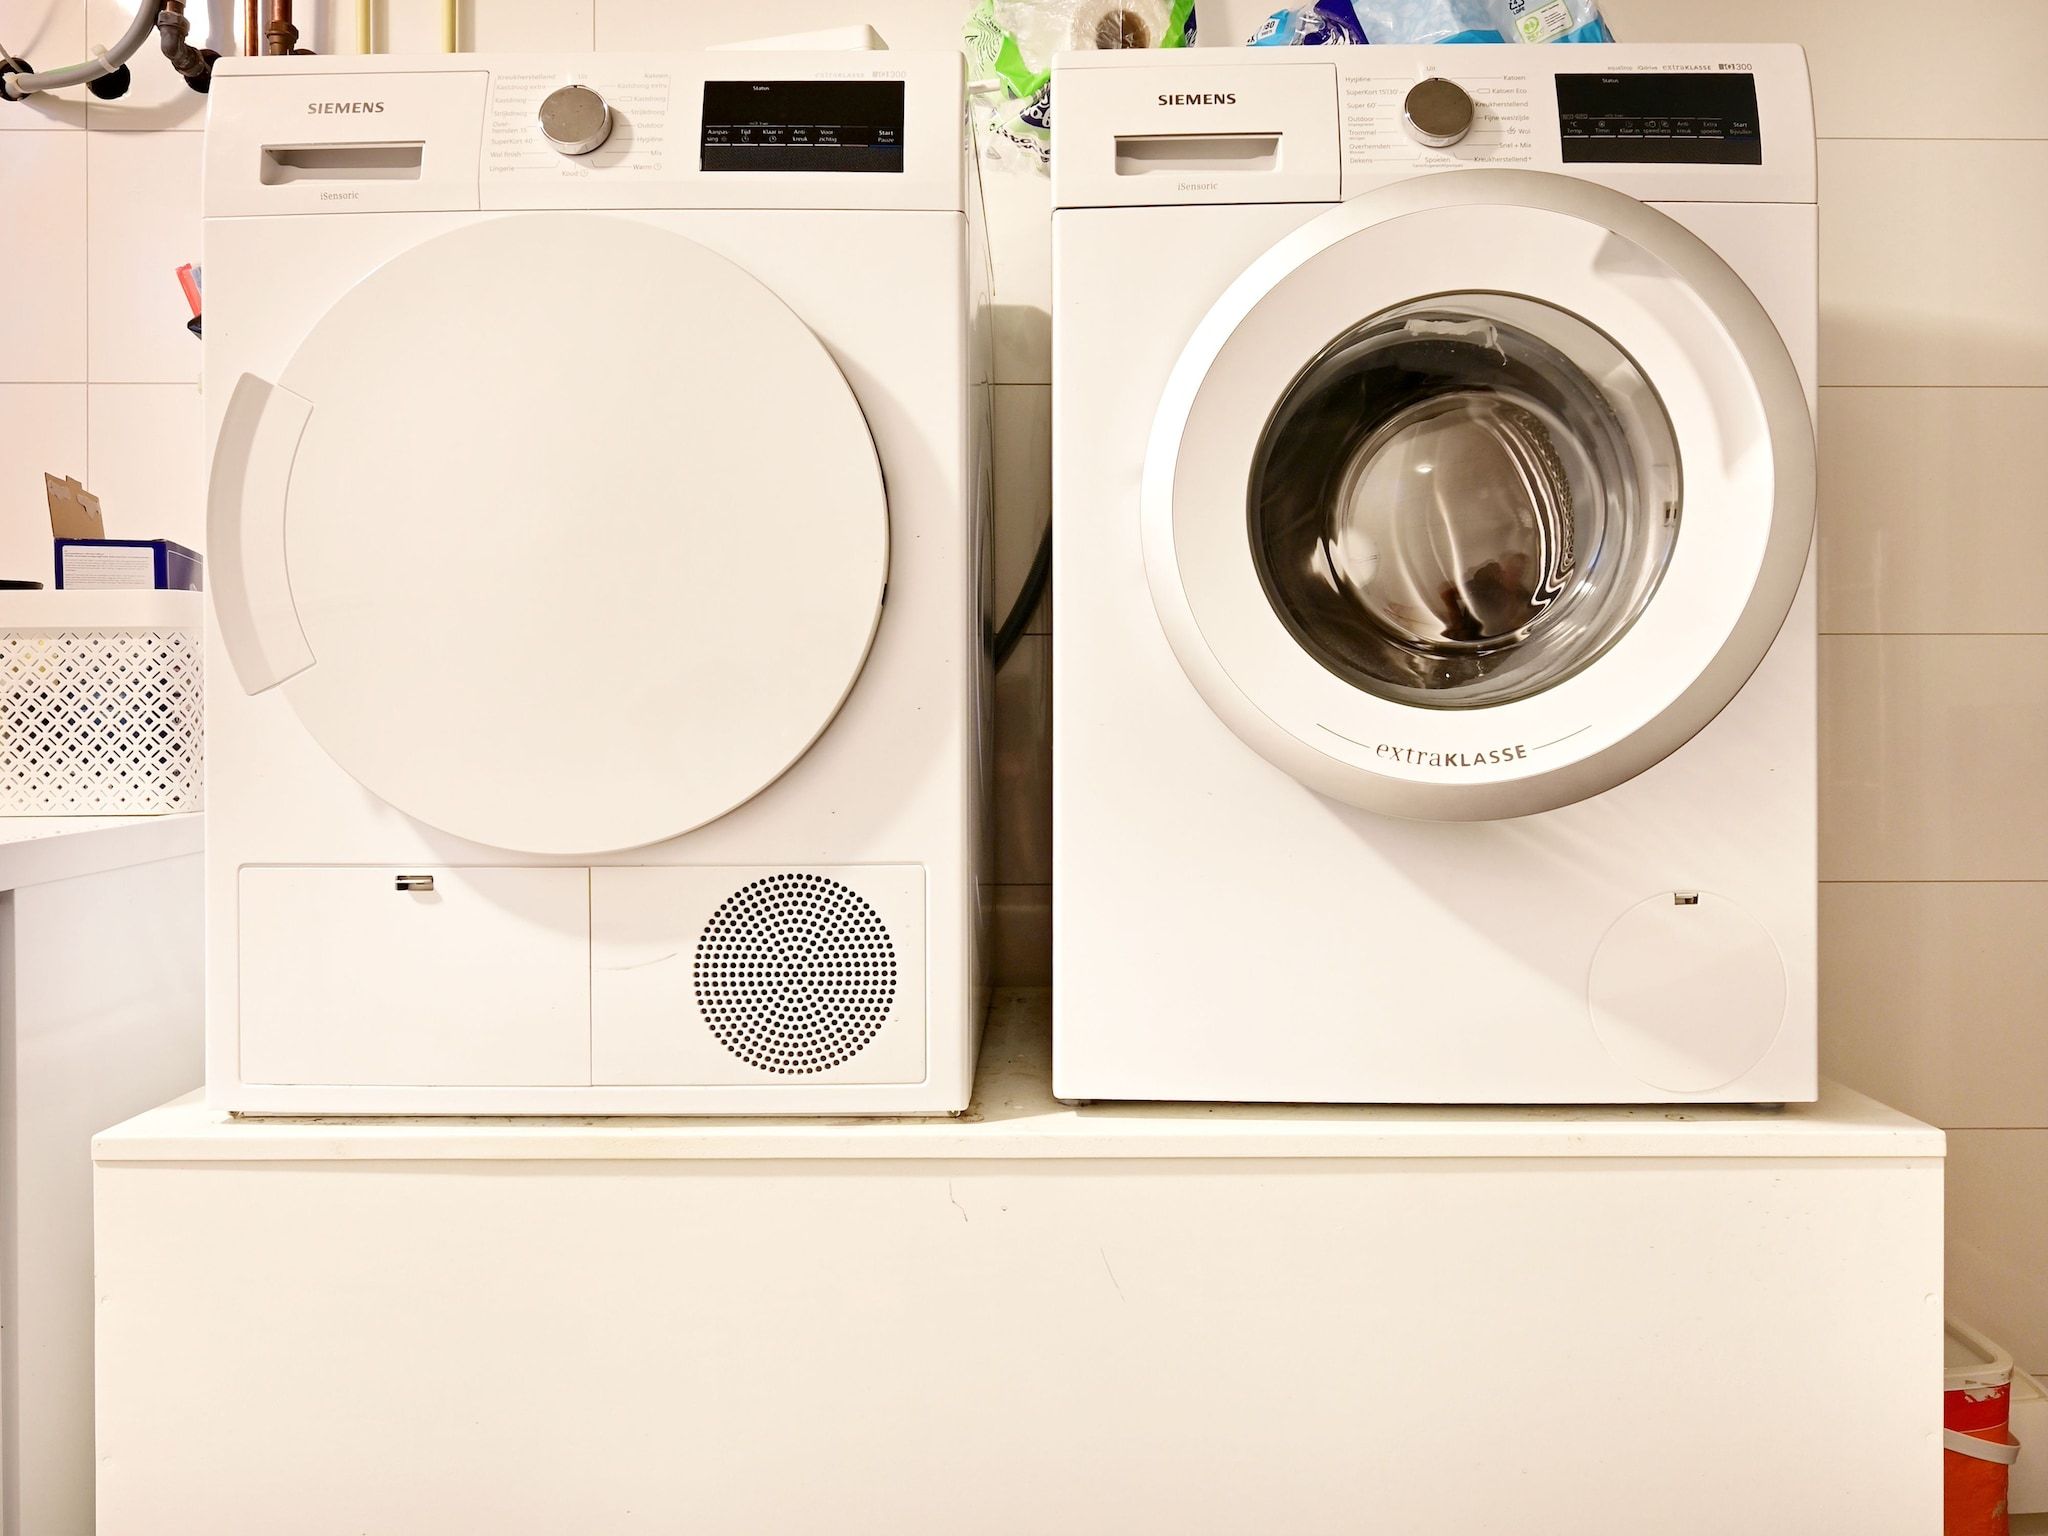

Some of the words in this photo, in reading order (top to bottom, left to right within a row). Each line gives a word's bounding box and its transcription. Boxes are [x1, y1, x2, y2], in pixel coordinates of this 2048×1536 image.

[1158, 93, 1237, 105] SIEMENS
[308, 101, 385, 114] SIEMENS
[489, 165, 514, 173] Lingerie
[1176, 182, 1218, 191] iSensoric
[320, 191, 360, 200] iSensoric
[1376, 743, 1527, 767] extraKLASSE
